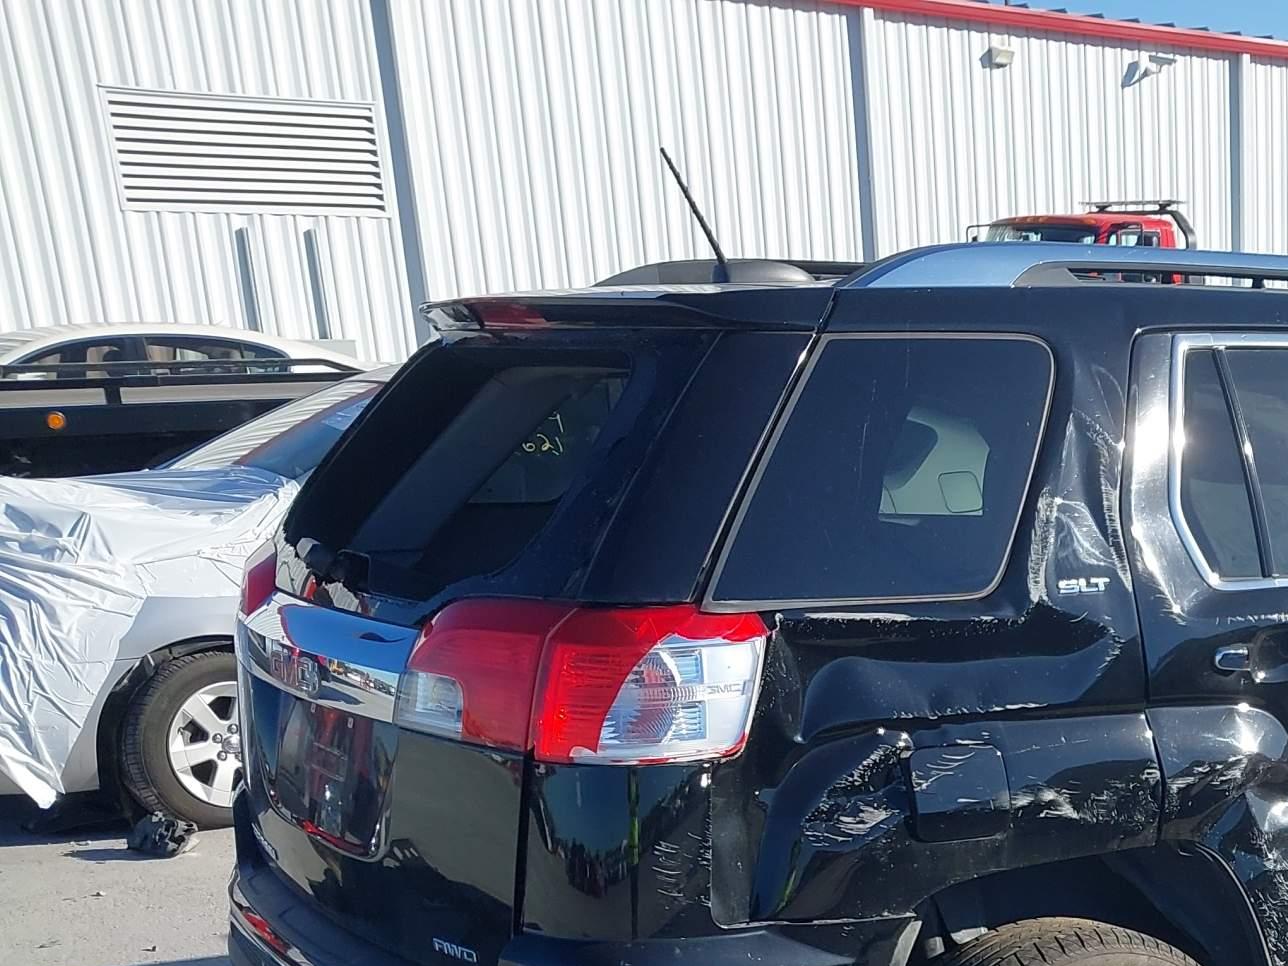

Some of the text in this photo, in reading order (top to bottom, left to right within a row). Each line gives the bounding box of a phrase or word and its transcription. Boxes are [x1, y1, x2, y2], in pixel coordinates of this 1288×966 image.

[1058, 577, 1111, 594] SLT
[271, 650, 317, 692] GMC
[432, 937, 478, 963] AWD
